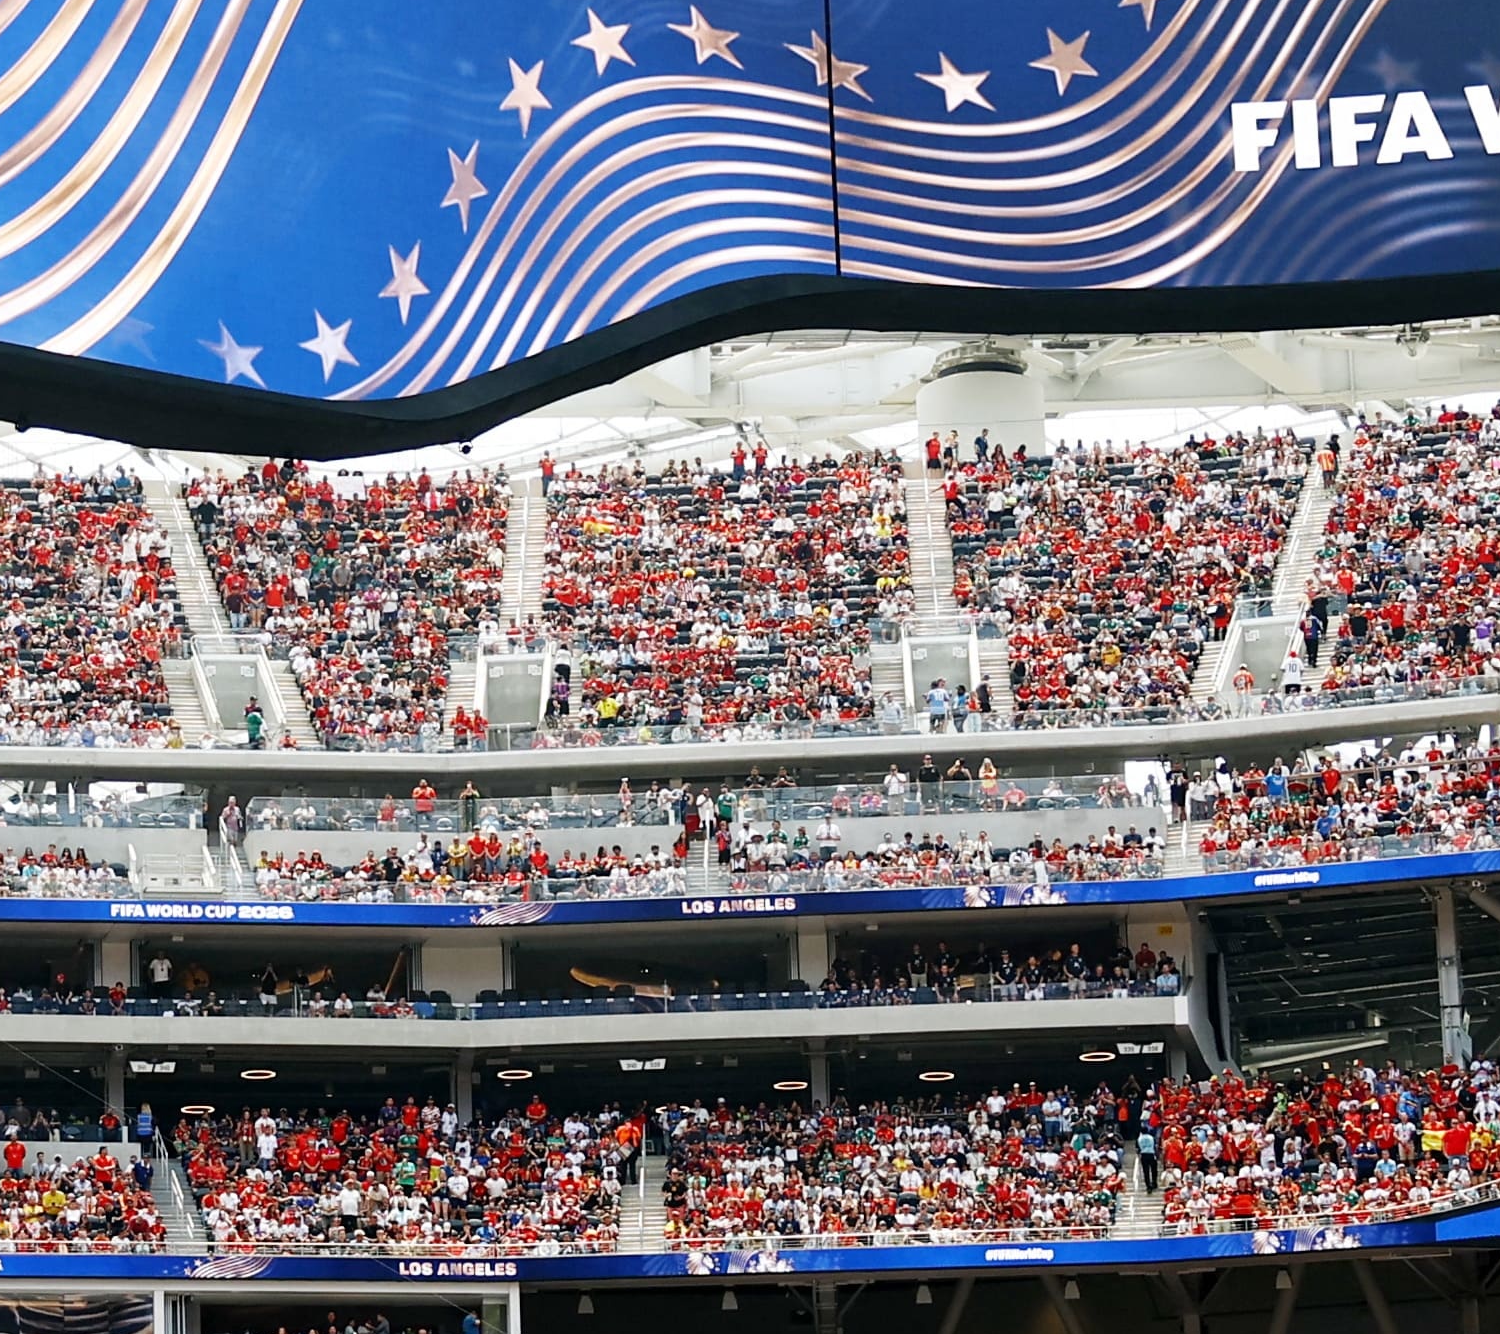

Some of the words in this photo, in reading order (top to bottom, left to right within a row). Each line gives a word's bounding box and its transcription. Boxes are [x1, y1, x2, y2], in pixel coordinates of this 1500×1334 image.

[1232, 94, 1452, 173] FIFA
[110, 904, 144, 917] FIFA
[146, 904, 203, 918] WORLD
[205, 905, 236, 918] CUP
[238, 906, 294, 920] 2026
[681, 900, 715, 914] LOS
[719, 897, 796, 912] ANGELES
[399, 1262, 433, 1275] LOS
[438, 1263, 516, 1276] ANGELES
